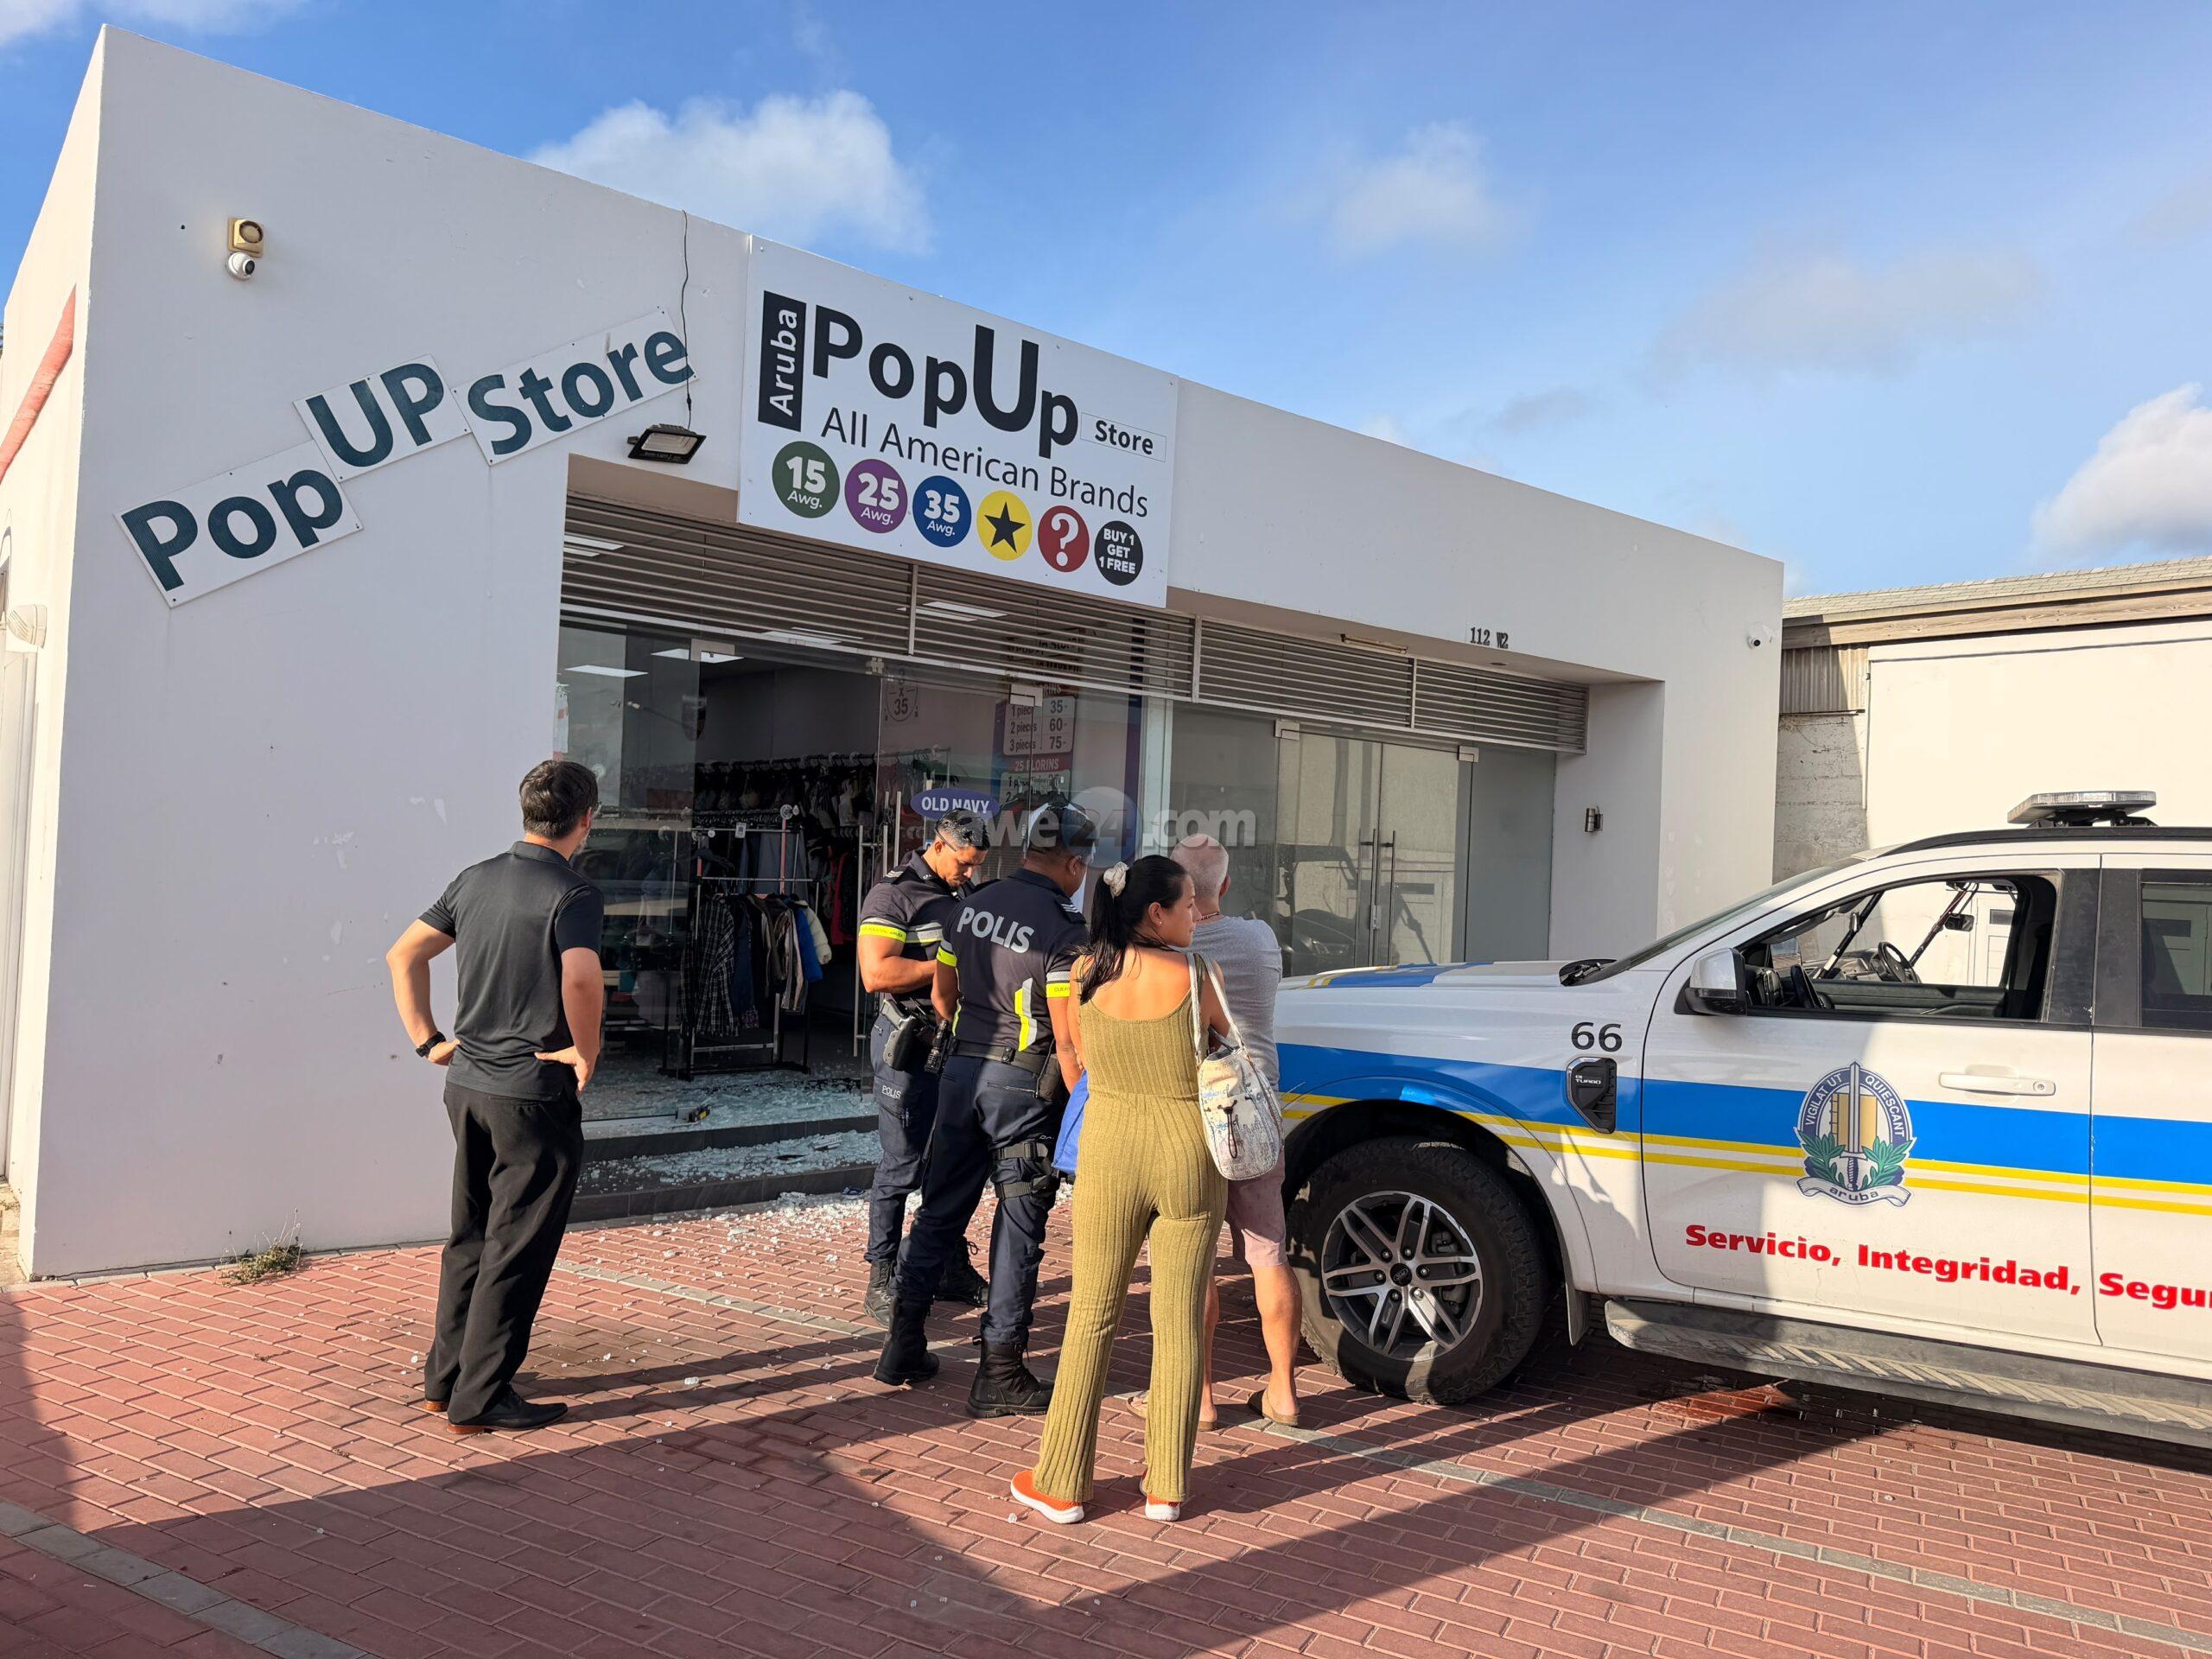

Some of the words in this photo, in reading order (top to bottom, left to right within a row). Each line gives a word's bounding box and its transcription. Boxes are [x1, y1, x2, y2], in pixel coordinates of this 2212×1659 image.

[768, 308, 798, 417] Aruba
[812, 304, 1079, 459] PopUp
[1094, 419, 1154, 456] Store
[120, 469, 344, 593] Pop
[306, 362, 445, 467] UP
[467, 330, 696, 456] Store
[820, 407, 868, 448] All
[880, 422, 1039, 492] American
[1051, 467, 1148, 518] Brands
[785, 455, 827, 494] 15
[786, 490, 823, 510] Awg.
[858, 472, 900, 512] 25
[860, 506, 894, 526] Awg.
[924, 489, 961, 524] 35
[926, 520, 956, 537] Awg.
[1103, 528, 1128, 543] BUY
[1128, 534, 1135, 546] 1
[1107, 543, 1131, 559] GET
[1098, 556, 1105, 569] 1
[1107, 557, 1136, 575] FREE
[1470, 626, 1491, 646] 112
[1496, 632, 1509, 649] W2
[893, 697, 909, 716] 35
[1010, 721, 1016, 734] 2
[1009, 739, 1015, 752] 3
[1014, 760, 1024, 772] 25
[921, 796, 950, 811] OLD
[952, 798, 990, 814] NAVY
[957, 907, 1035, 954] POLIS
[1570, 1021, 1623, 1052] 66
[882, 1084, 902, 1099] POLIS
[1805, 1087, 1829, 1126] VIGILAT
[1828, 1073, 1843, 1086] UT
[1865, 1075, 1906, 1137] QUIESCANT
[1829, 1185, 1878, 1202] aruba
[1686, 1224, 1841, 1267] Servicio,
[1858, 1243, 2082, 1296] Integridad,
